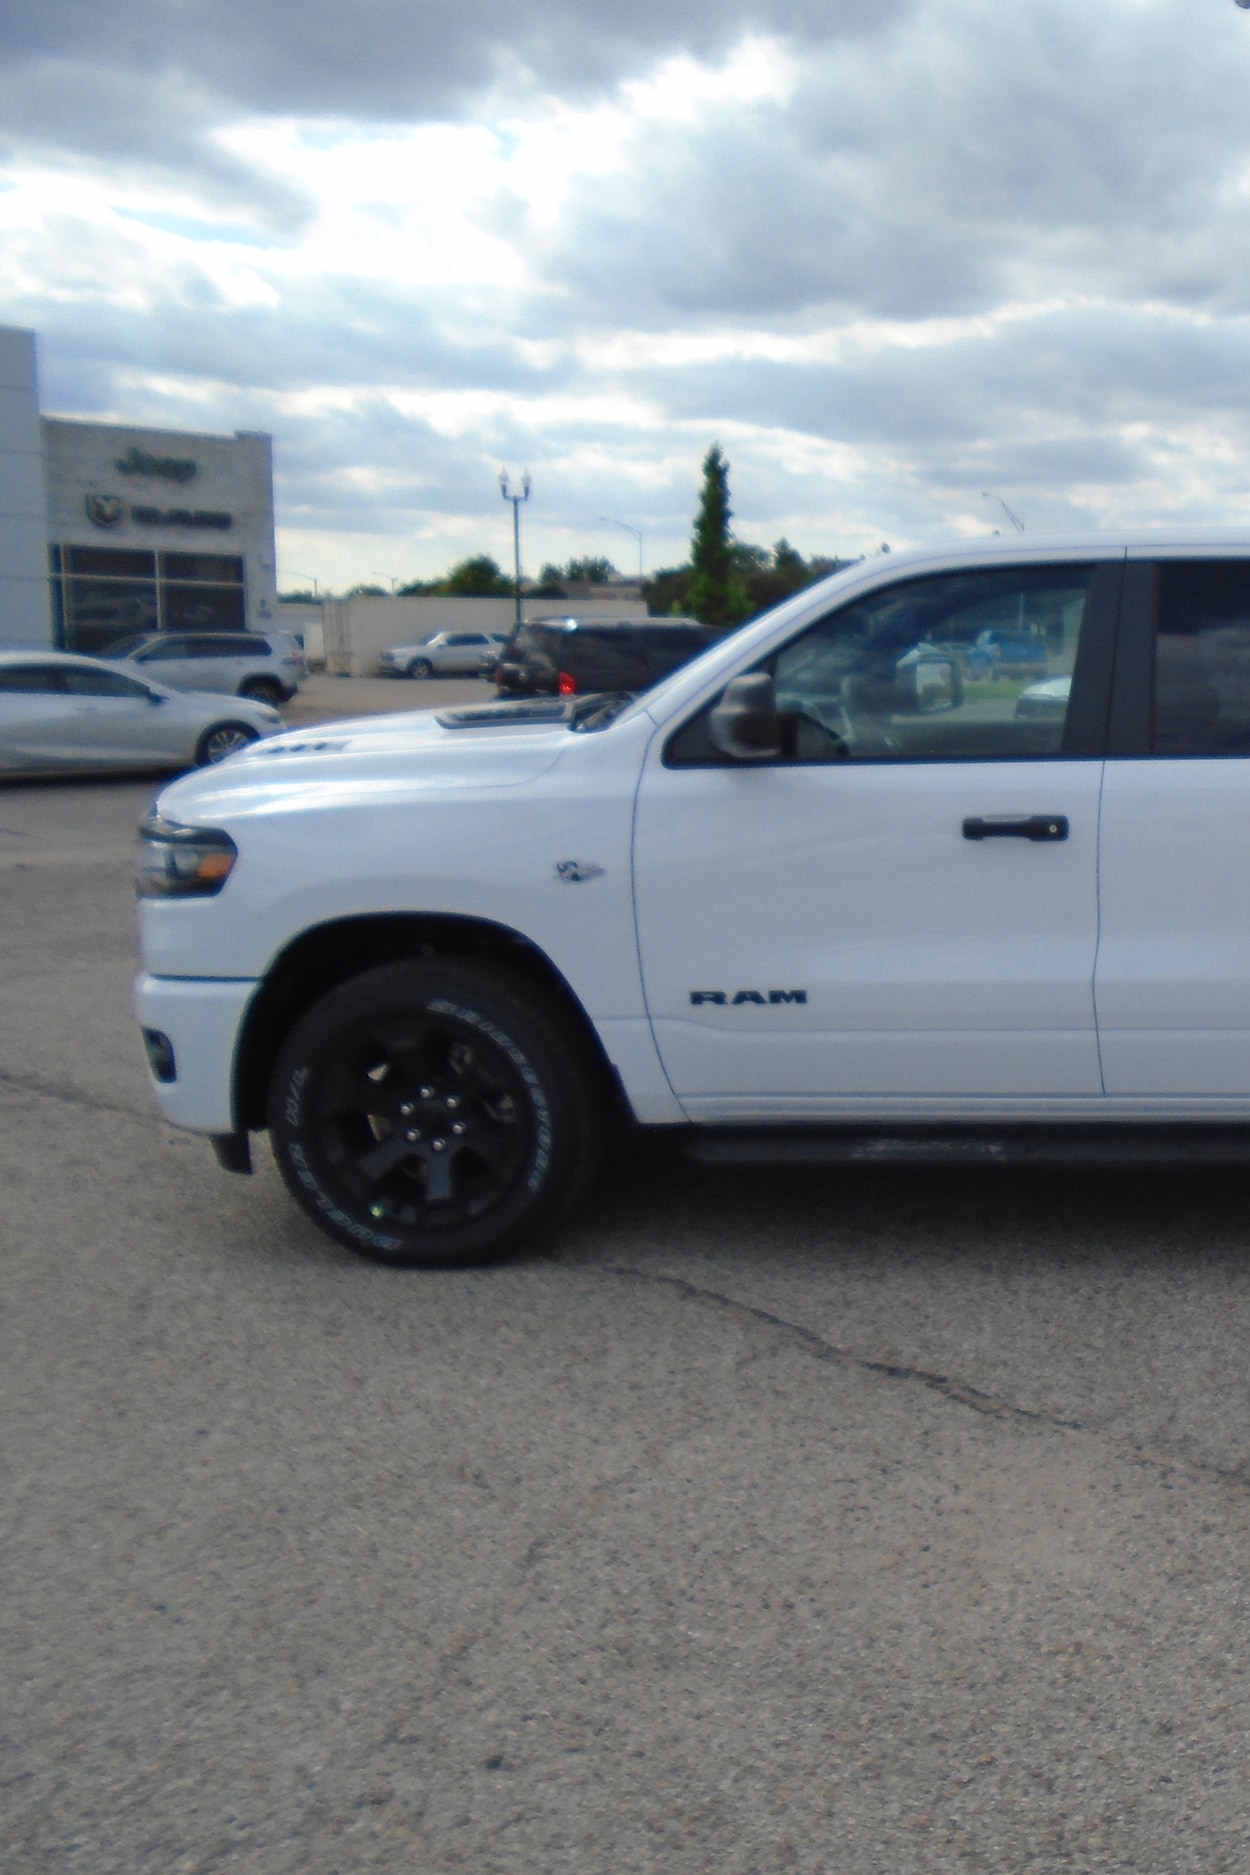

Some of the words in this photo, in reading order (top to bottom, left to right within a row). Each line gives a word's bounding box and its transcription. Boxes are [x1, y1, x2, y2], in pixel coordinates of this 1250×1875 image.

[115, 448, 197, 483] Jeep
[131, 505, 232, 529] RAM
[690, 990, 808, 1005] RAM
